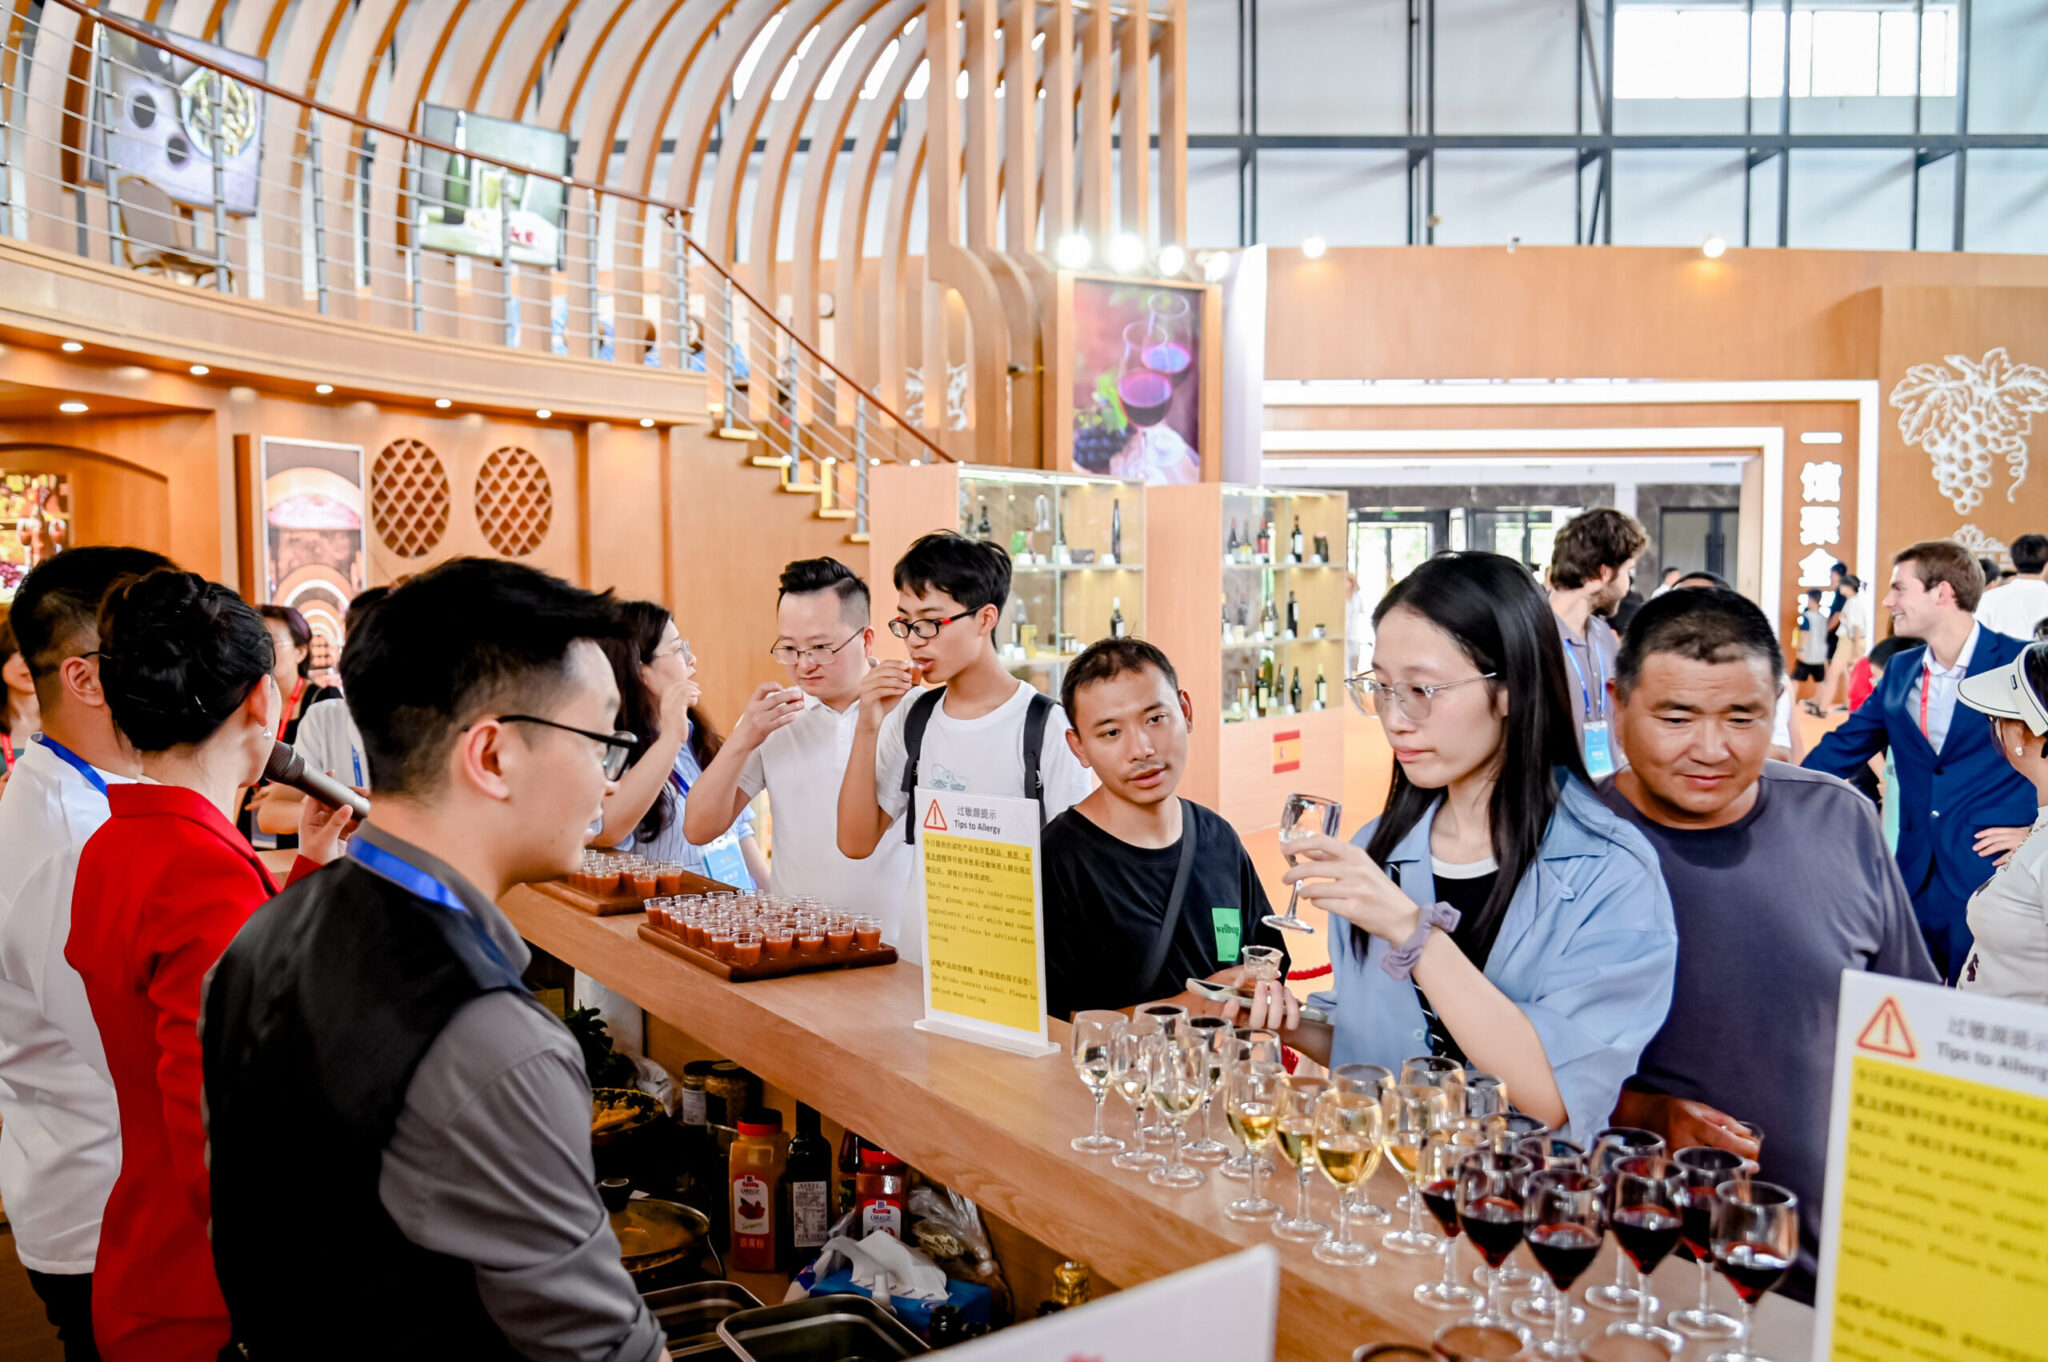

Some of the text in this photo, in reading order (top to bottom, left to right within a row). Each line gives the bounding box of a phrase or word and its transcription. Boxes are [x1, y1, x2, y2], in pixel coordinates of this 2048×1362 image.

[1797, 431, 1843, 626] 一馆聚全
[954, 820, 1001, 835] Tips to Allergy
[957, 806, 997, 820] 过敏源提示
[1935, 1041, 2048, 1084] Tips to Allerg
